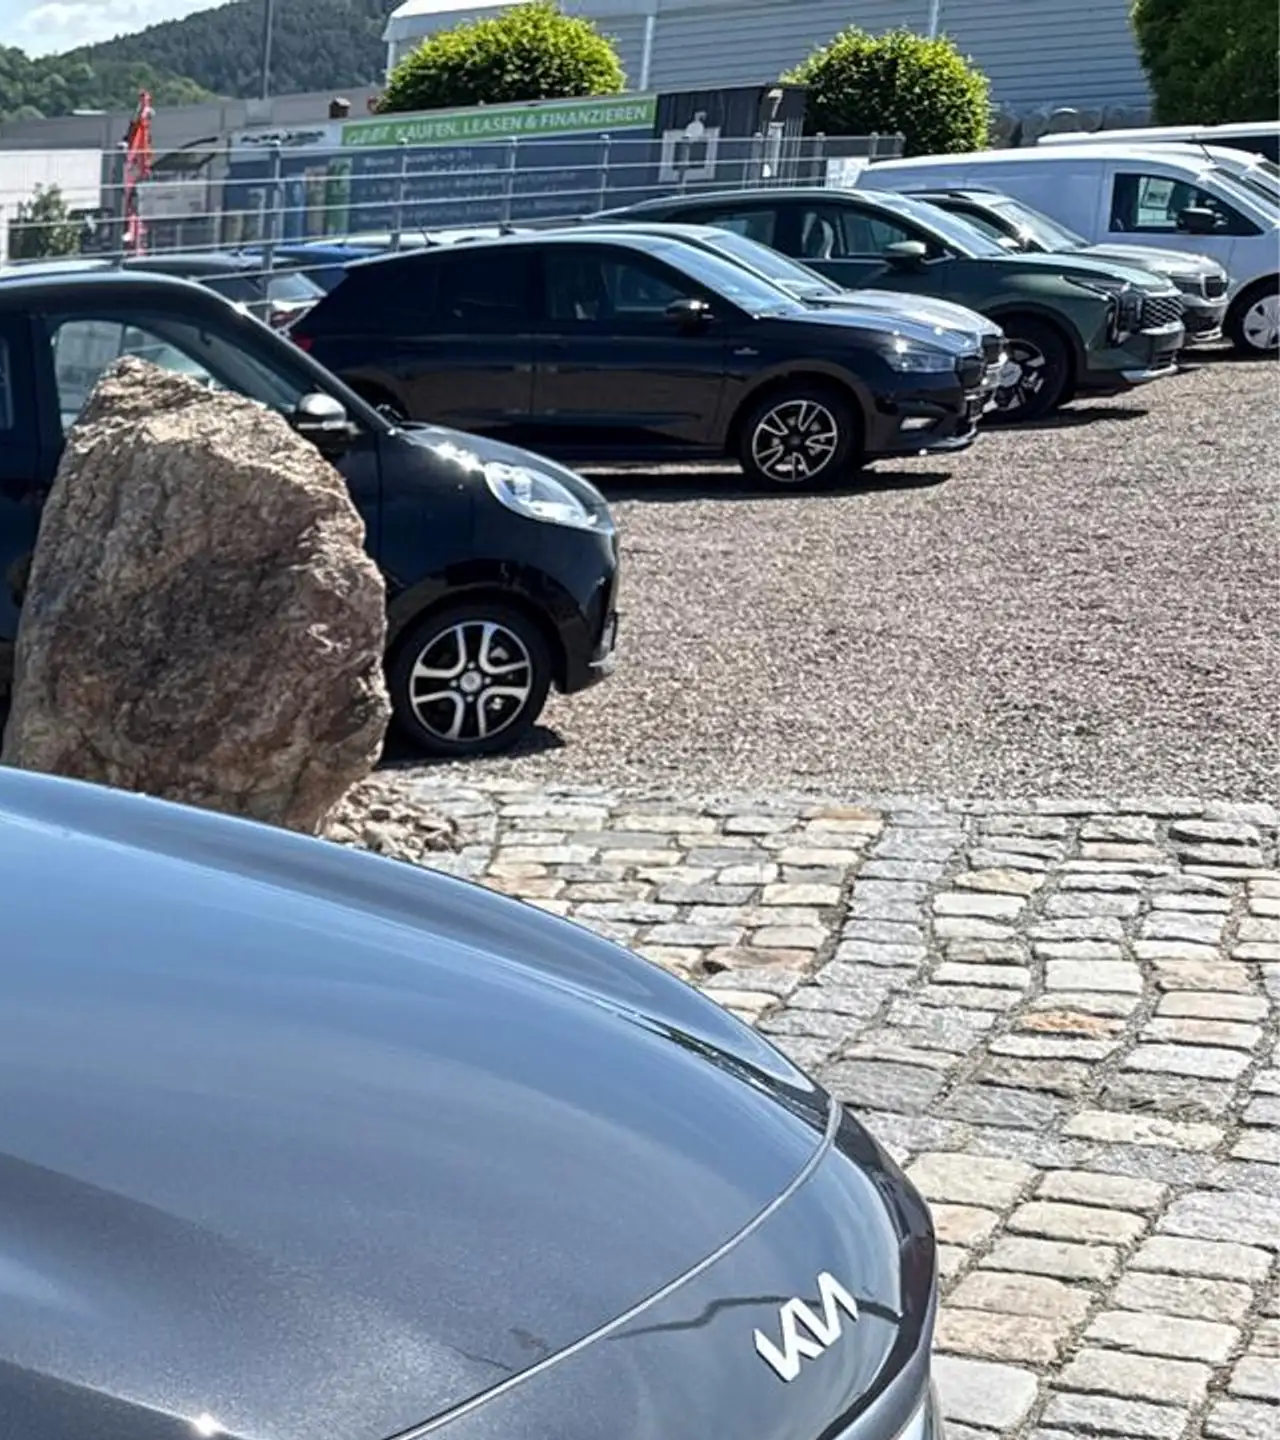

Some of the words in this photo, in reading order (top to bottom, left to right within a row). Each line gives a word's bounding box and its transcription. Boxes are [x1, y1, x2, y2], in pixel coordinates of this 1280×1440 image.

[463, 114, 522, 133] LEASEN
[524, 116, 538, 130] &
[540, 105, 648, 127] FINANZIEREN
